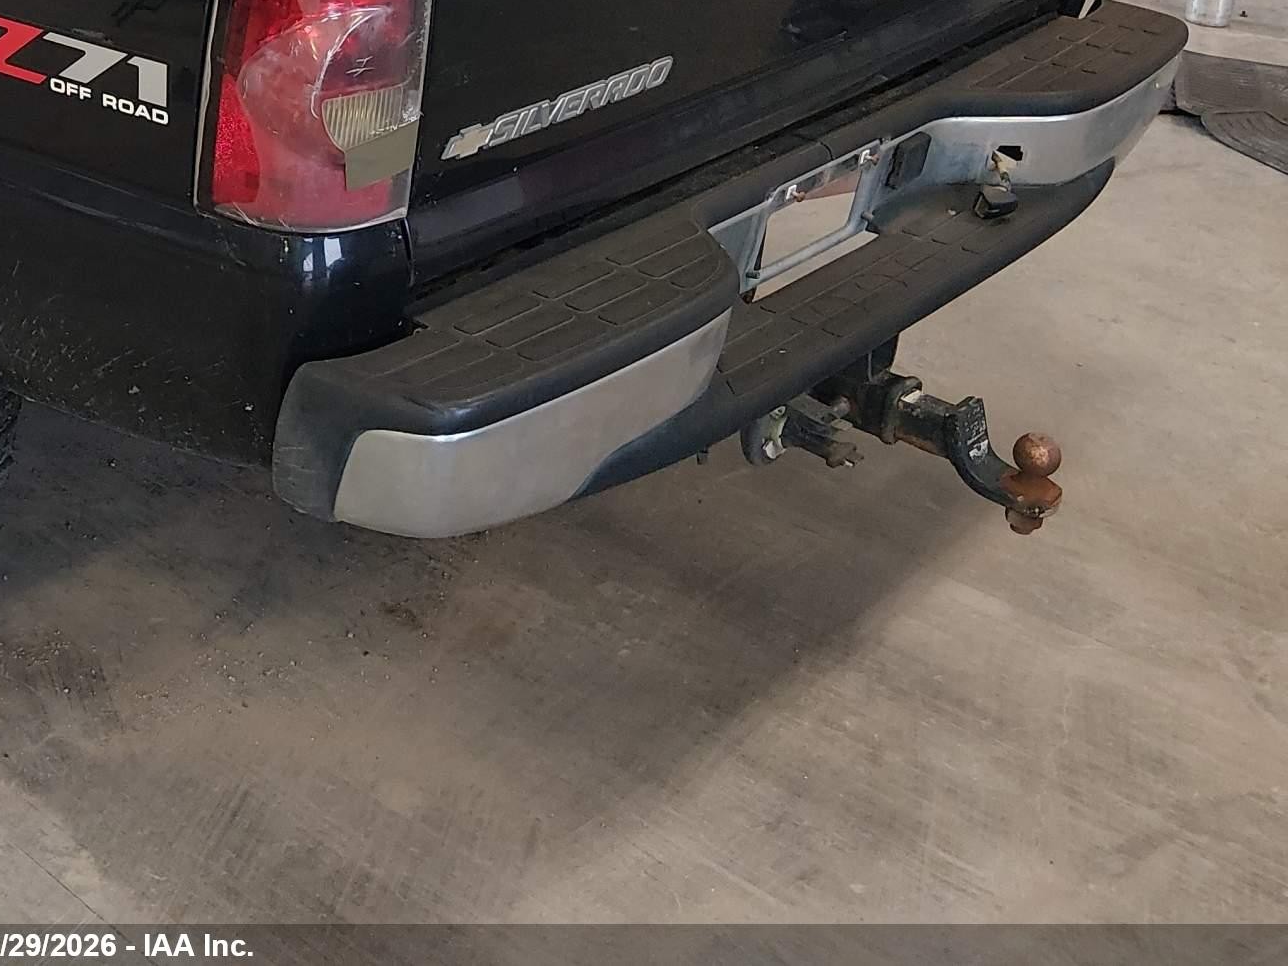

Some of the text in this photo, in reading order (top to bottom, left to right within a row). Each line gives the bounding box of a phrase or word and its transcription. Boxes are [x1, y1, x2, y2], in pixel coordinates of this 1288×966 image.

[50, 77, 169, 125] OFF ROAD
[488, 56, 673, 146] SILVERADO
